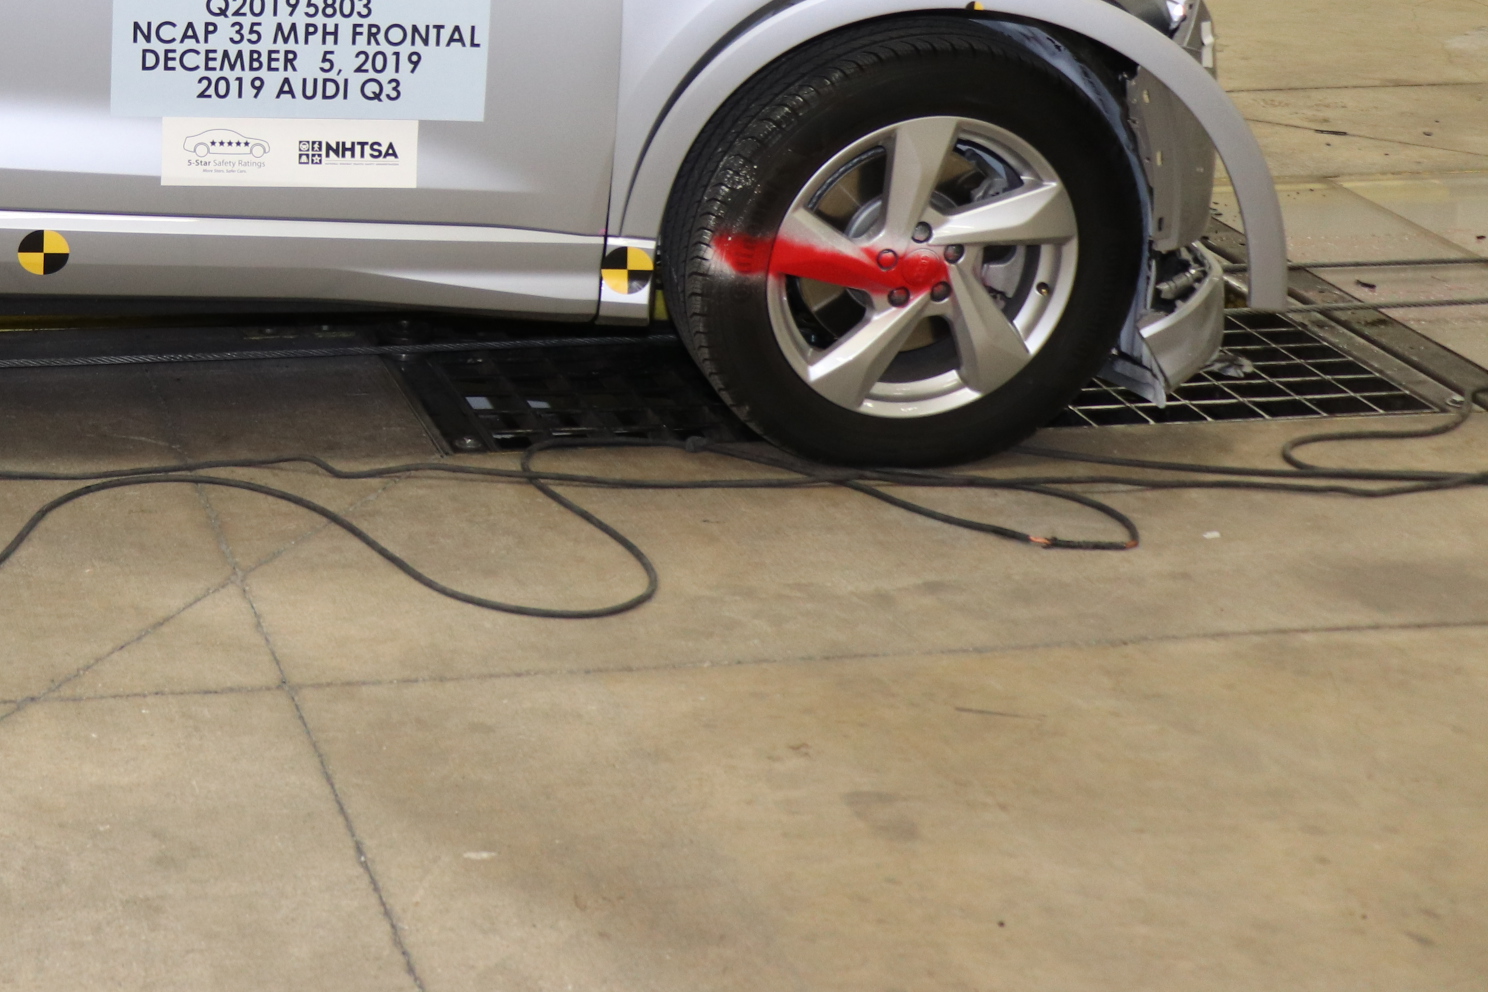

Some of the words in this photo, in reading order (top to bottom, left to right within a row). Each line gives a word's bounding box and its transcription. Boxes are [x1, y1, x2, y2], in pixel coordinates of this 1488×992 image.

[133, 21, 218, 44] NCAP
[229, 22, 262, 44] 35
[273, 22, 338, 45] MPH
[352, 24, 480, 47] FRONTAL
[142, 49, 297, 72] DECEMBER
[319, 51, 342, 76] 5,
[354, 51, 421, 74] 2019
[197, 76, 264, 99] 2019
[276, 77, 348, 100] AUDI
[360, 78, 401, 102] Q3
[326, 141, 398, 159] NHTSA
[238, 160, 265, 168] Ratings
